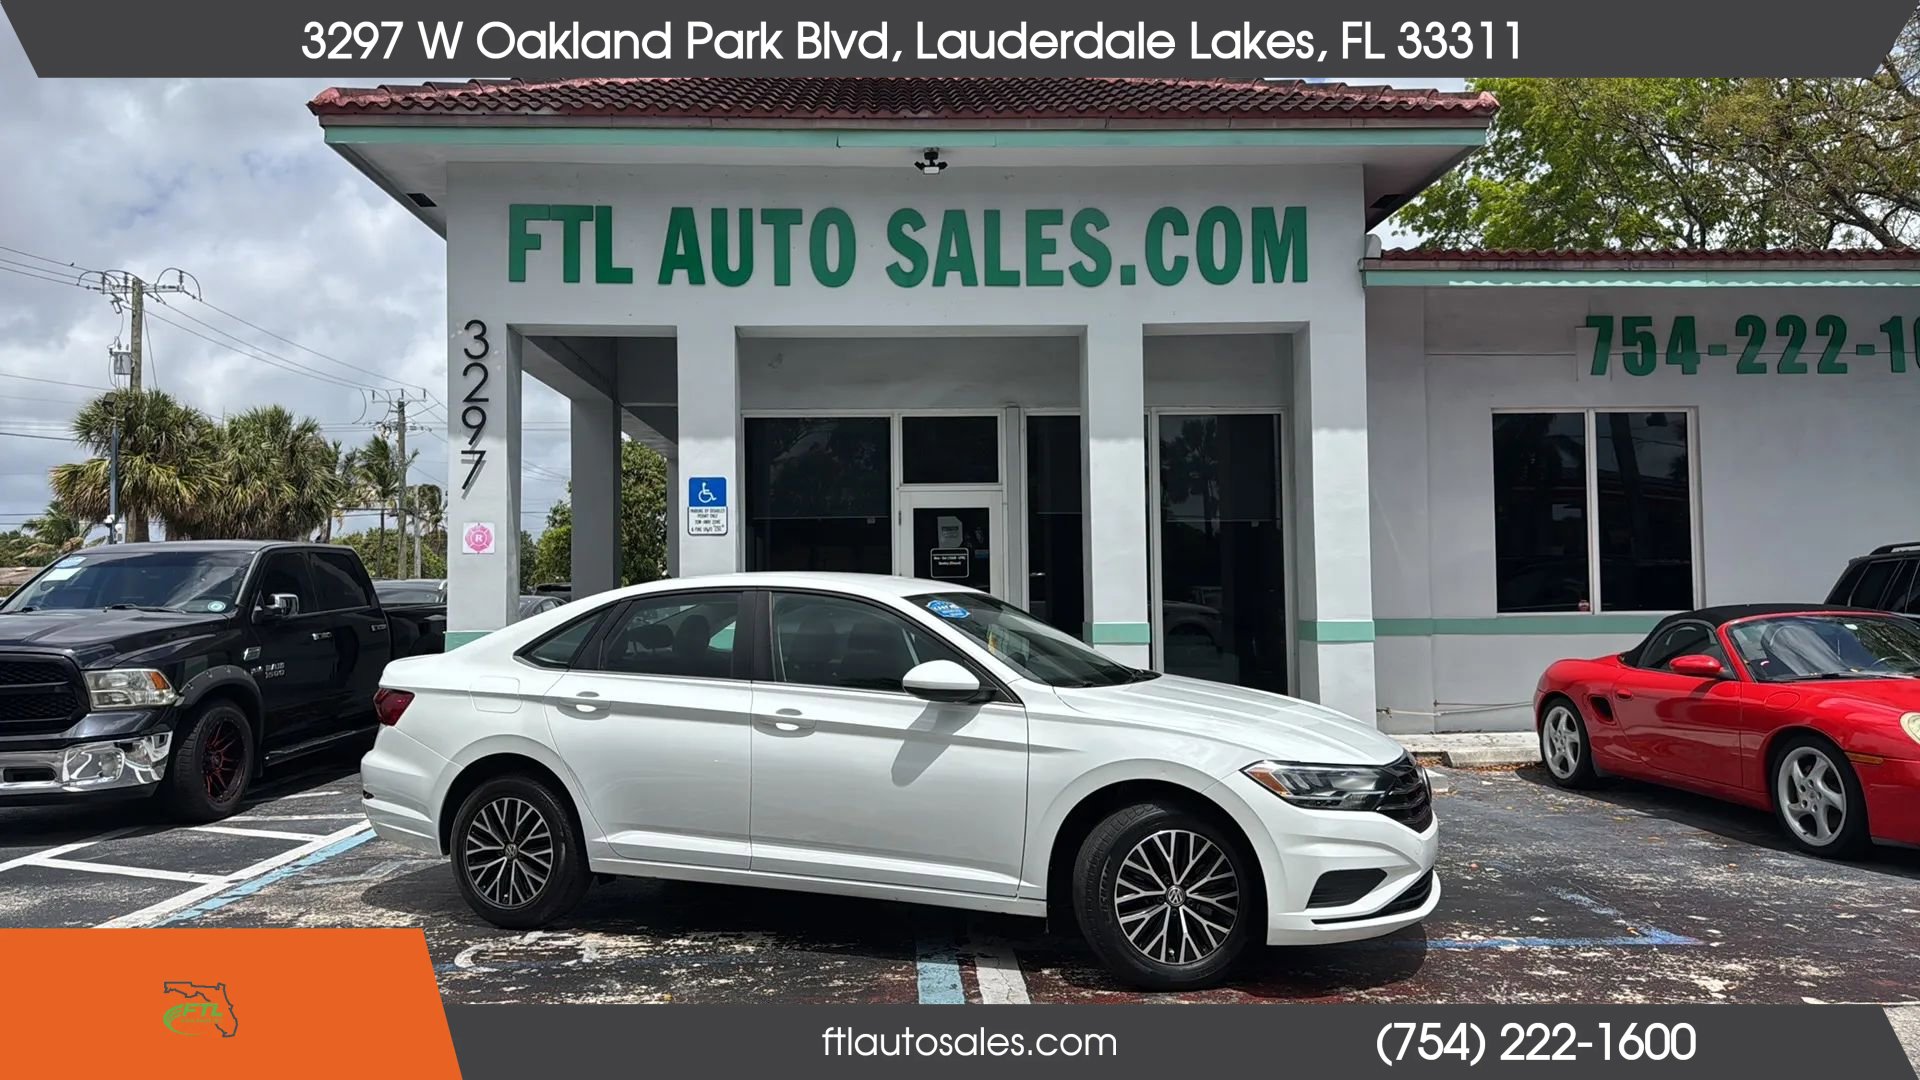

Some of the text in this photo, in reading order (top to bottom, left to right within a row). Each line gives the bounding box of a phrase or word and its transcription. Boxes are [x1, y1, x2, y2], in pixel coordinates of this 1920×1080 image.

[508, 205, 1309, 288] FTL AUTO SALES.COM
[1585, 314, 1920, 377] 754-222-1
[461, 319, 490, 491] 3297
[475, 534, 484, 543] R
